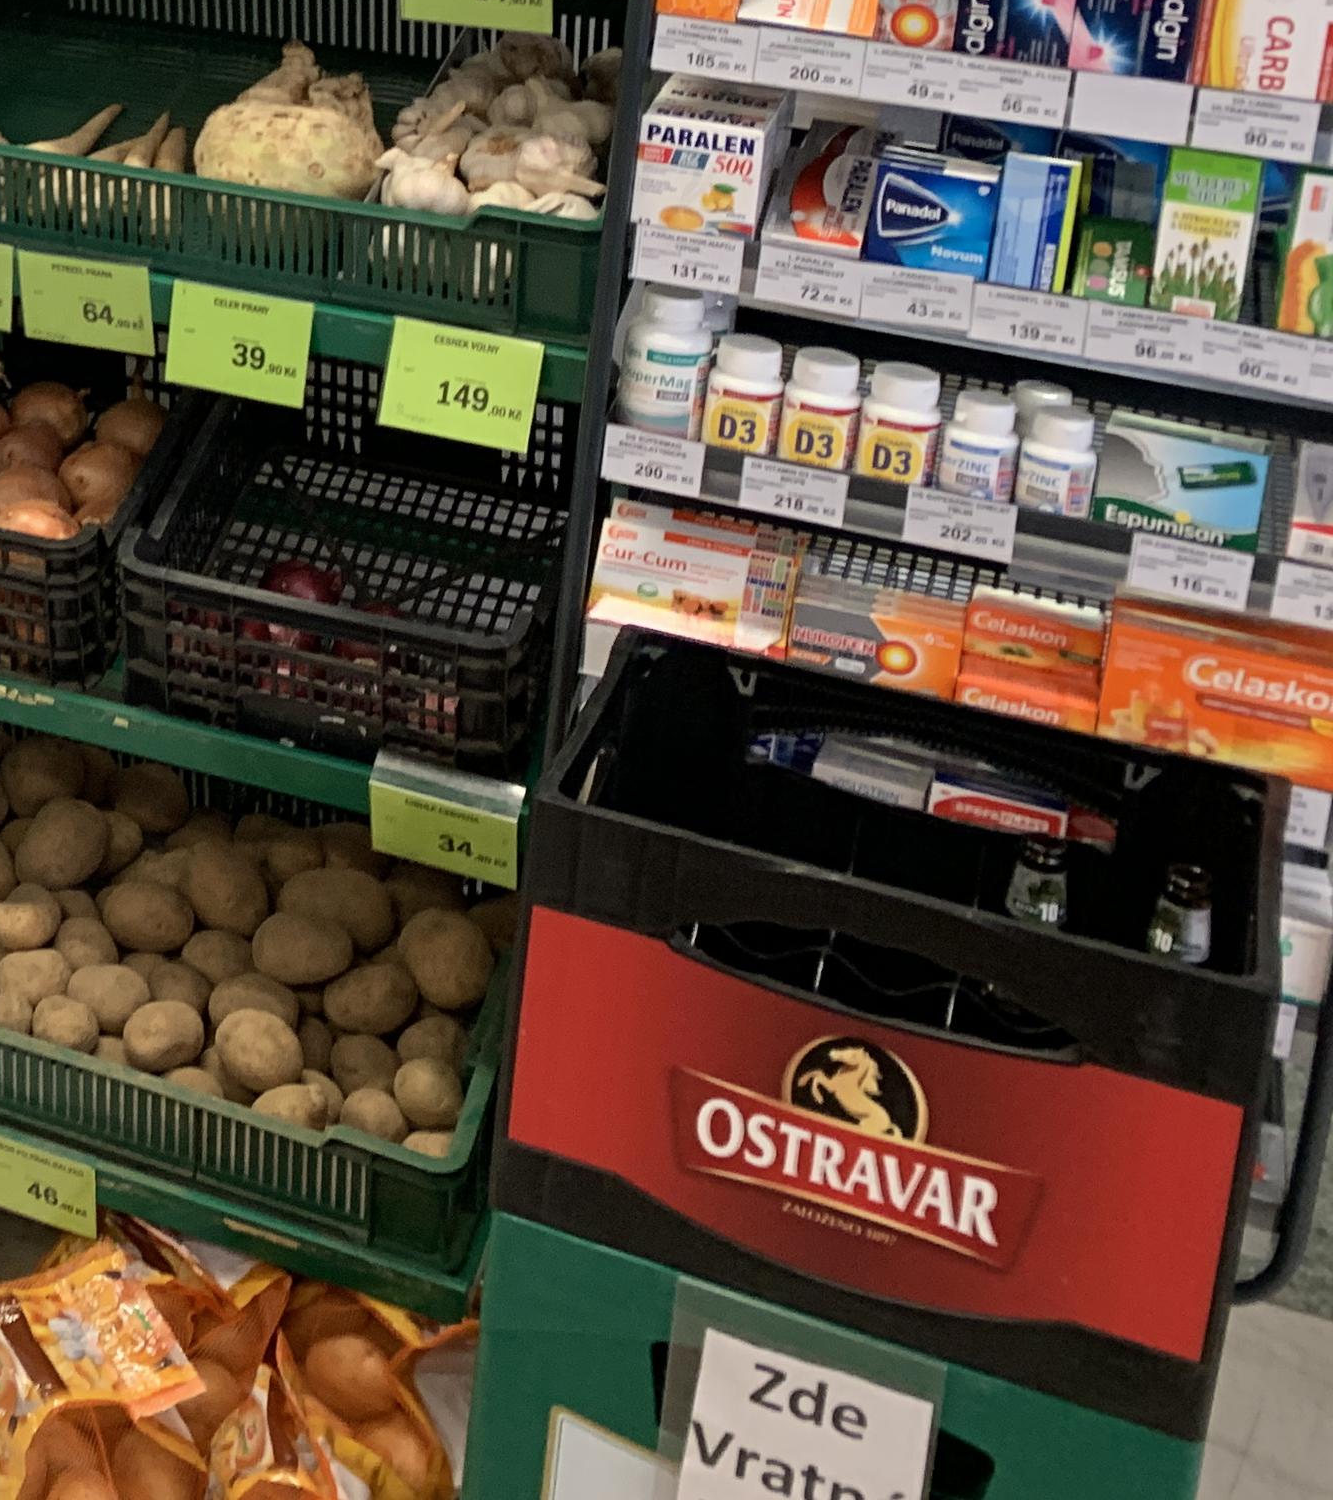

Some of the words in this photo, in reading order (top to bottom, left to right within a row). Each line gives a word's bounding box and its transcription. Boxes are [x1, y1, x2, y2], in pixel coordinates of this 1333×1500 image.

[647, 123, 755, 156] PARALEN
[712, 156, 754, 177] 500
[885, 198, 943, 222] Panadol
[930, 245, 984, 264] Novum
[231, 342, 283, 375] 39,90
[436, 380, 507, 421] 149,00
[718, 413, 757, 445] D3
[795, 427, 834, 459] D3
[872, 443, 912, 476] D3
[1105, 503, 1225, 546] Espumisan
[601, 543, 688, 572] Cur-Cum
[791, 625, 877, 657] NUROFEN
[972, 610, 1067, 648] Celaskon
[1187, 657, 1333, 712] Celasko
[962, 687, 1061, 726] Celaskon
[1039, 902, 1058, 923] 10
[1153, 927, 1173, 953] 10
[696, 1098, 999, 1248] OSTRAVAR
[749, 1362, 869, 1441] Zde
[692, 1419, 907, 1500] Vratn
